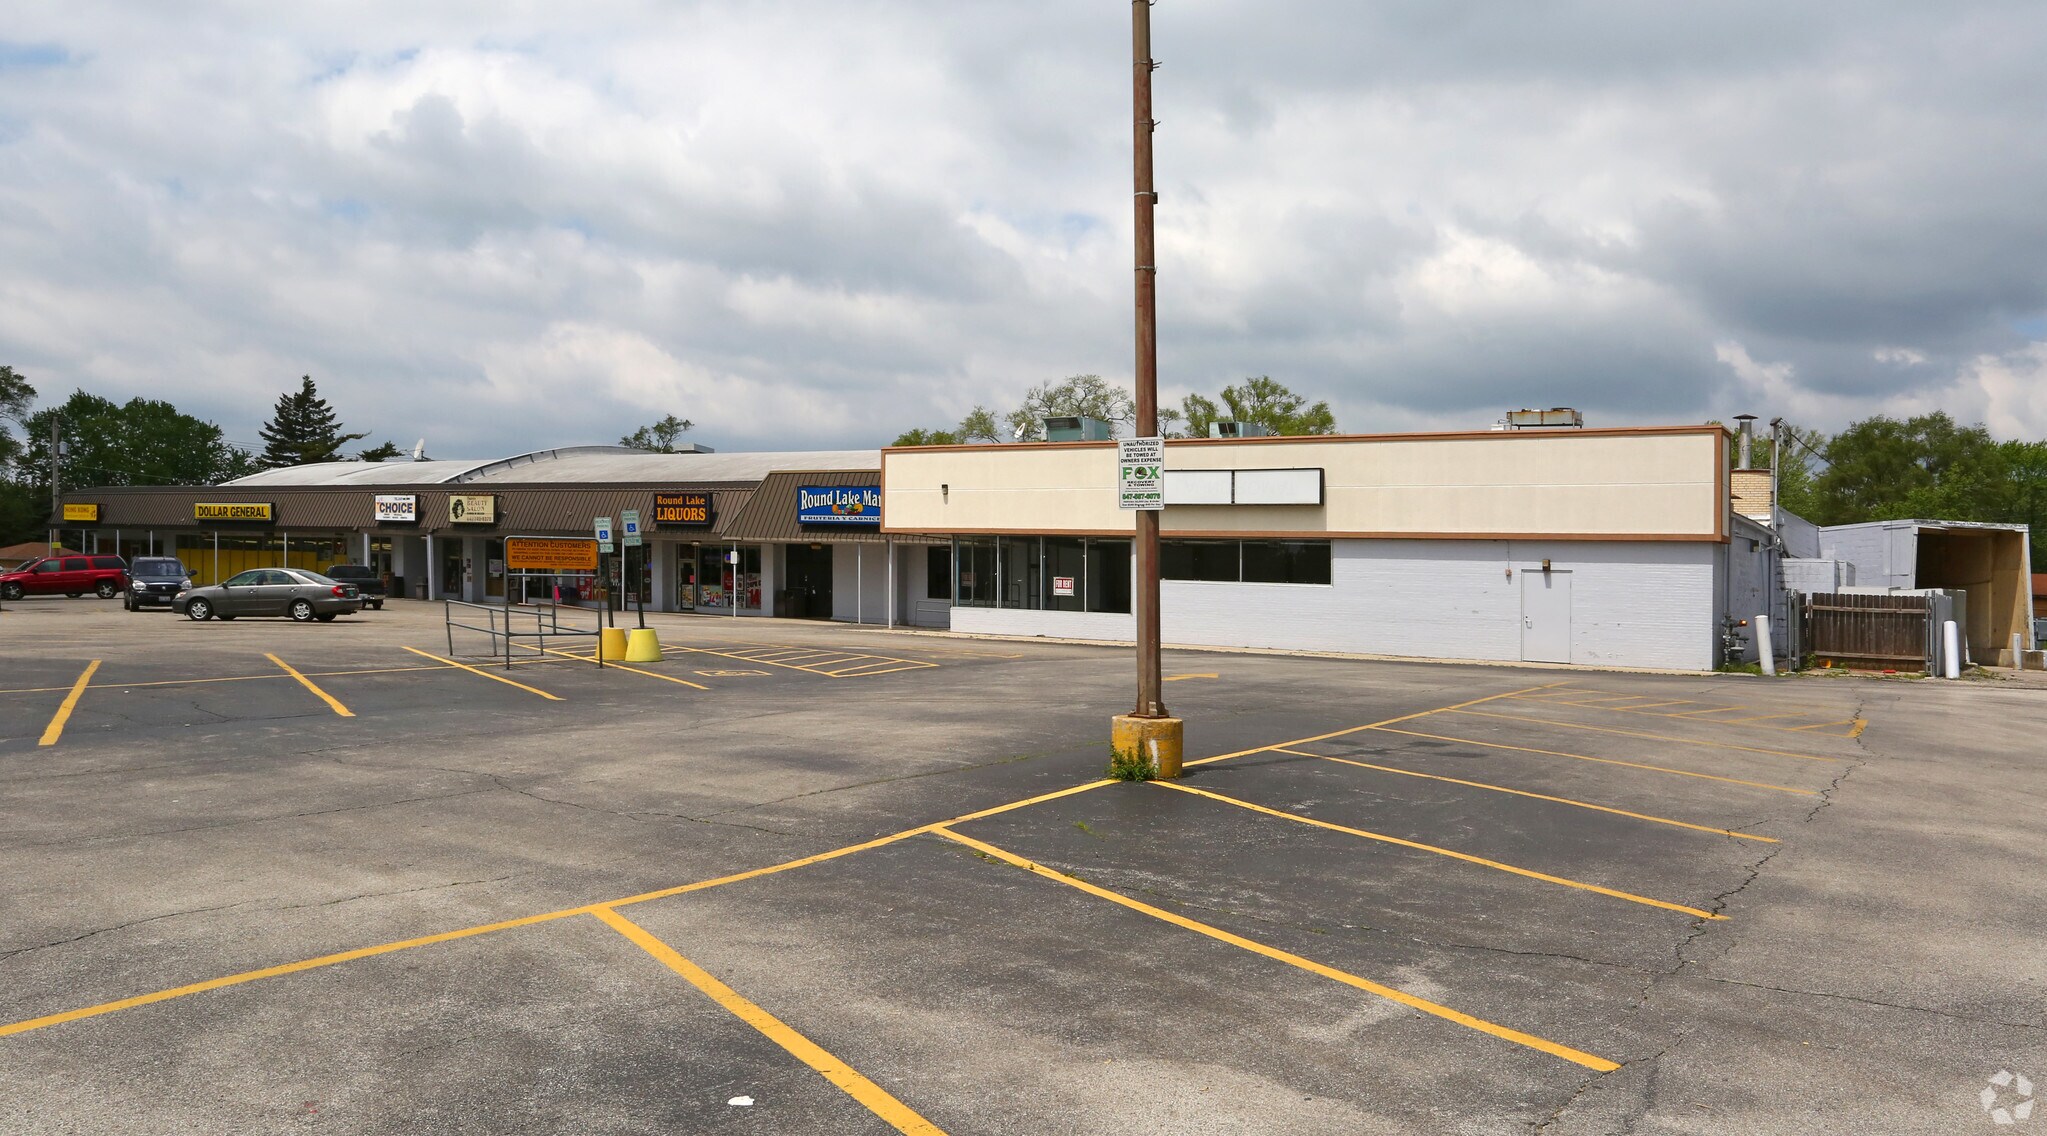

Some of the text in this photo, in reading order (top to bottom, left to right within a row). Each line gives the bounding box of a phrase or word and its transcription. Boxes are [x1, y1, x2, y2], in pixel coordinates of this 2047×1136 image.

[657, 496, 705, 504] Round Lake
[801, 490, 833, 510] Round
[836, 490, 860, 505] Lake
[198, 506, 266, 517] DOLLAR GENERAL
[380, 502, 413, 513] CHOICE
[657, 508, 706, 521] LIQUORS
[1063, 580, 1072, 588] RENT
